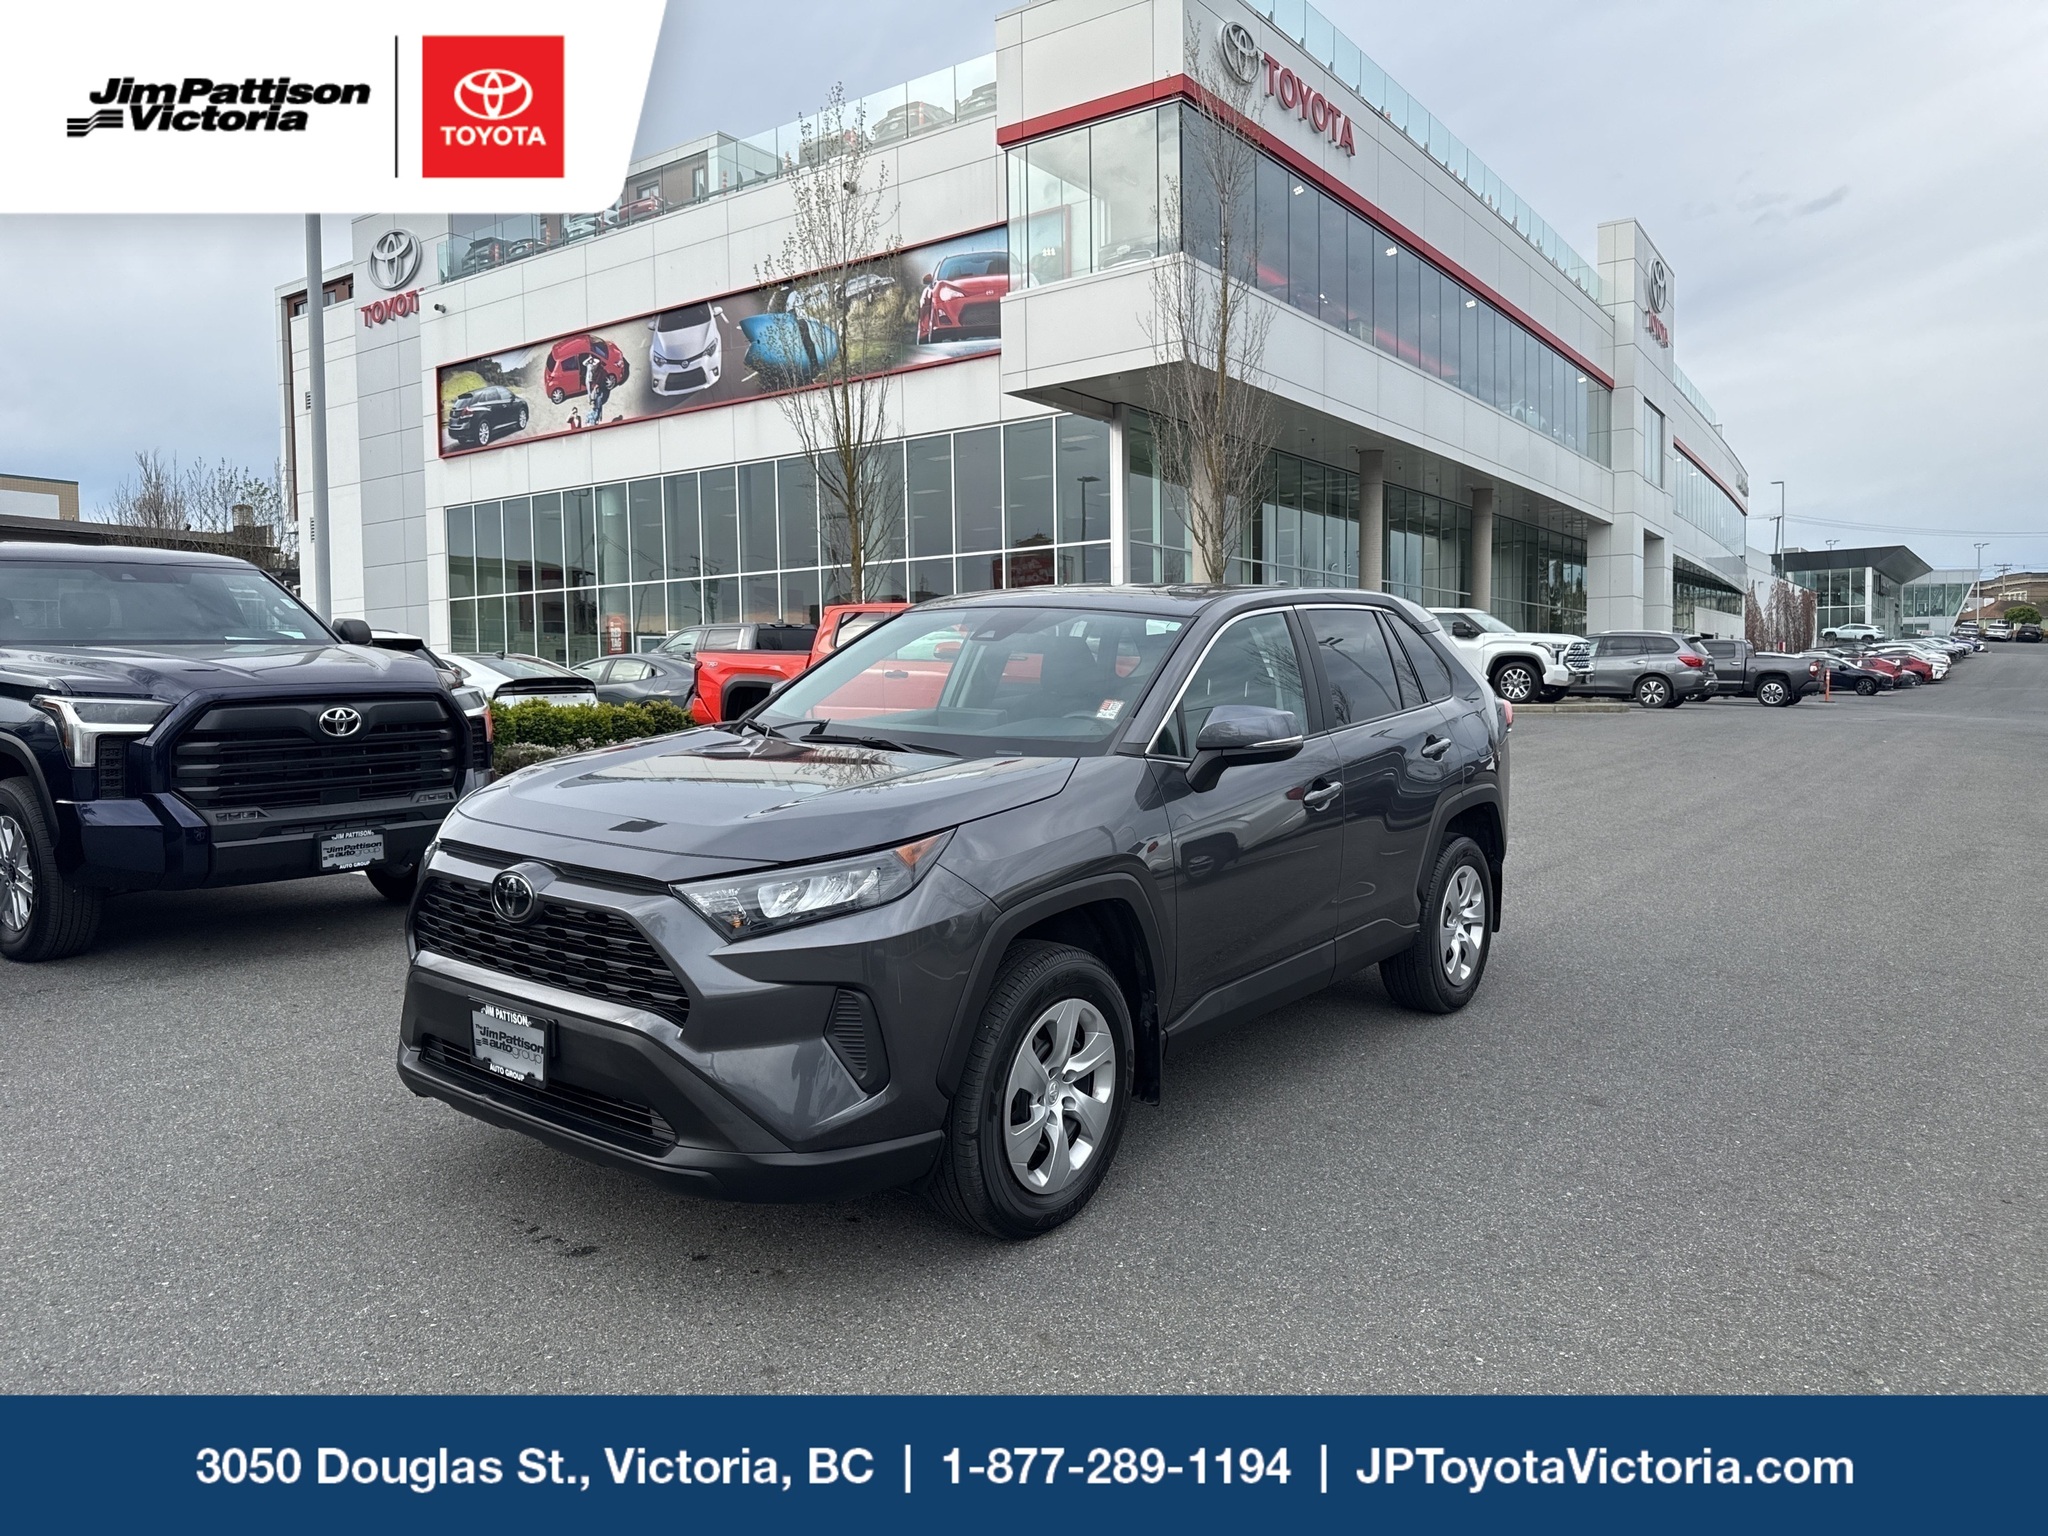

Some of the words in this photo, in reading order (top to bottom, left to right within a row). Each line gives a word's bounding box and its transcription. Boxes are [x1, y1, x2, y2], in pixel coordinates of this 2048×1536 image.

[1263, 51, 1356, 157] TOYOTA
[360, 288, 425, 328] TOYOT
[333, 832, 345, 840] JIM
[345, 829, 372, 838] PATTISON
[485, 1004, 495, 1017] JIM
[495, 1007, 529, 1028] PATTISON
[489, 1063, 504, 1075] AUTO
[504, 1068, 525, 1081] GROUP
